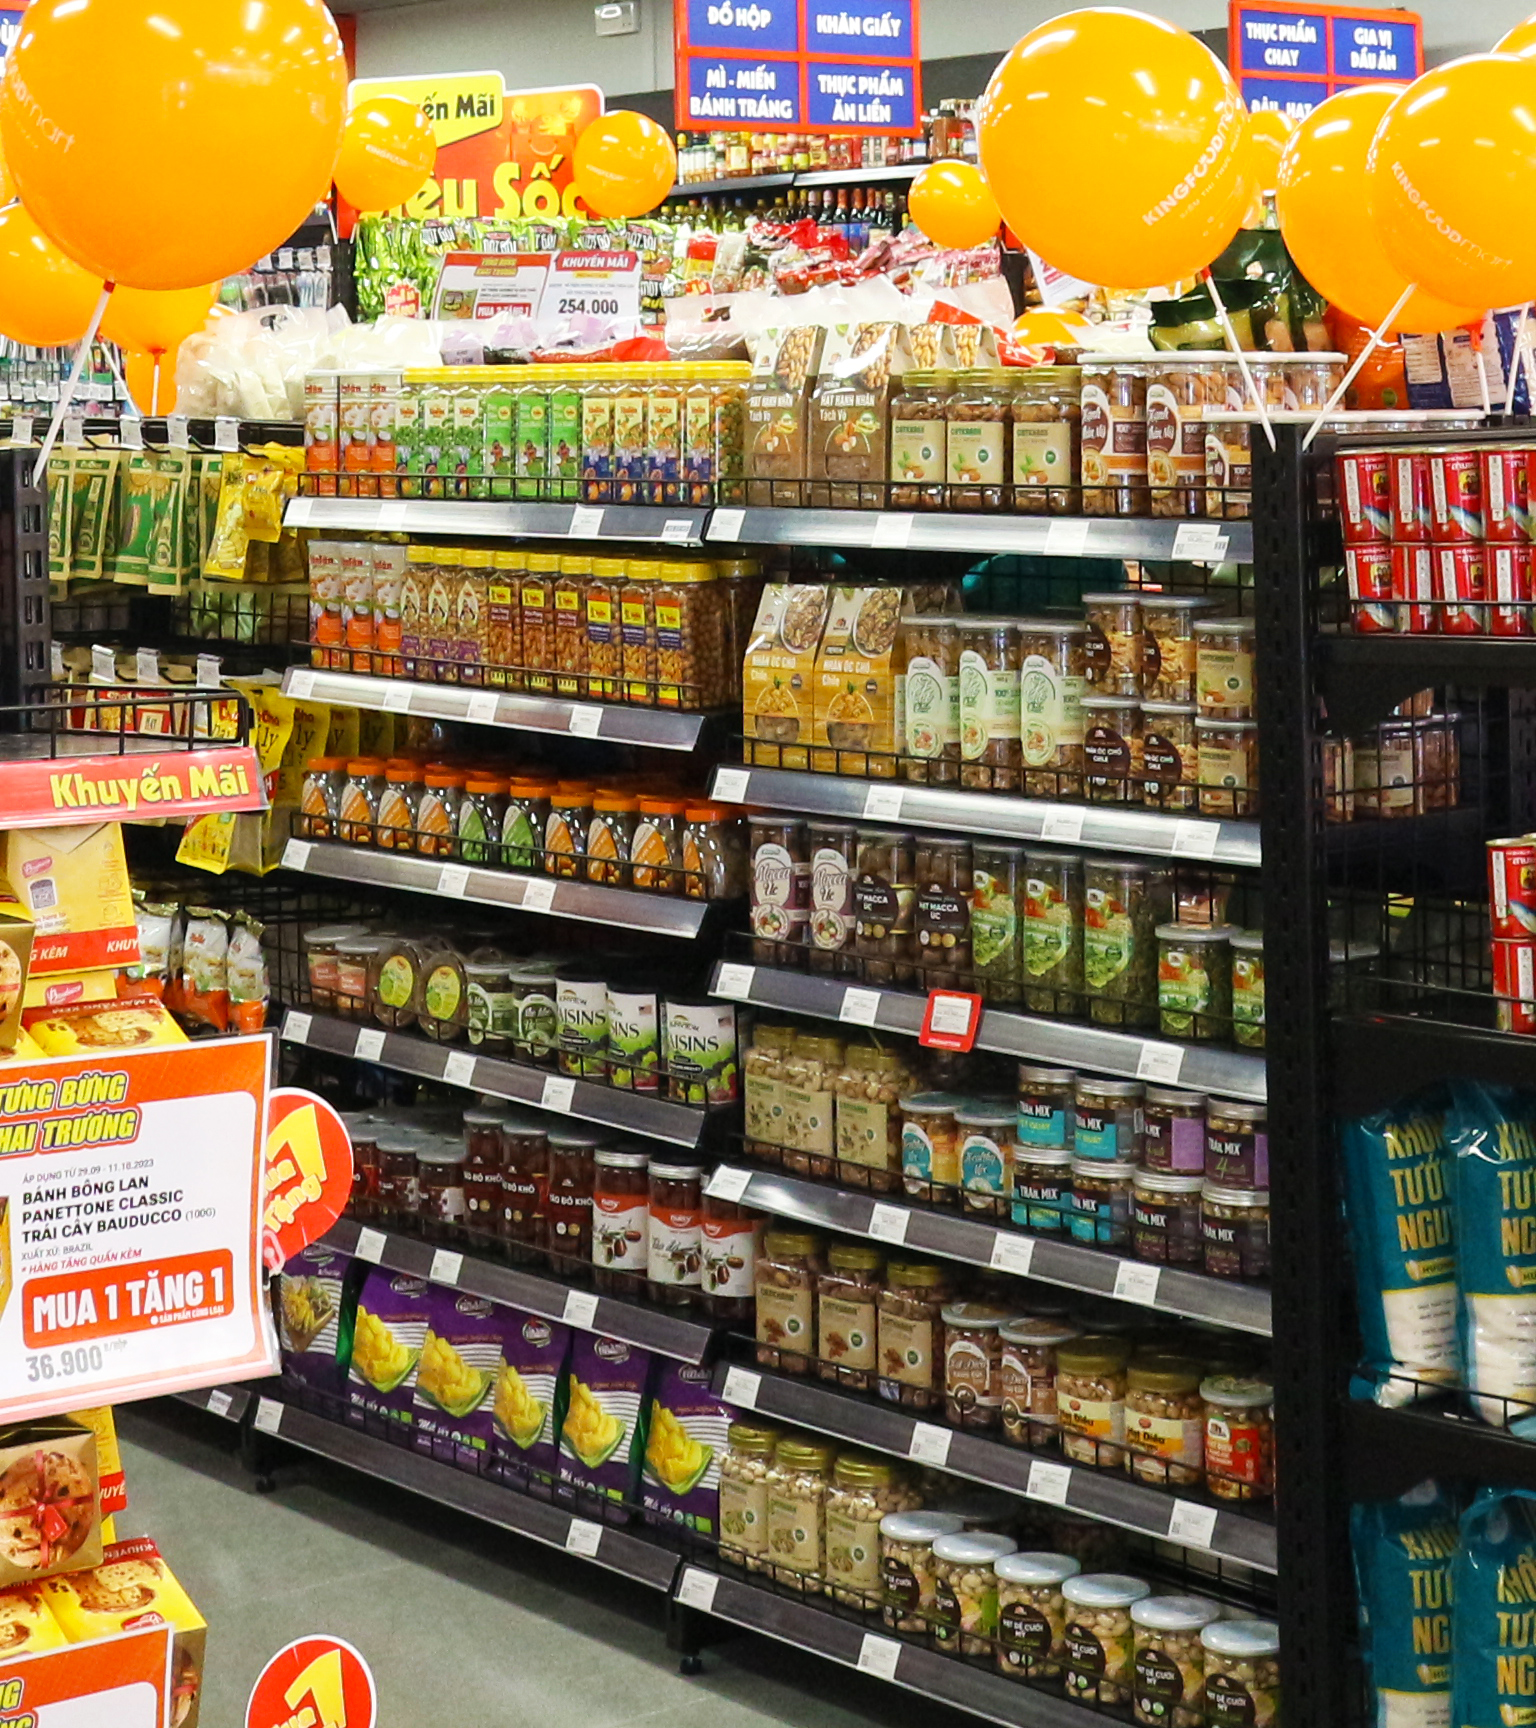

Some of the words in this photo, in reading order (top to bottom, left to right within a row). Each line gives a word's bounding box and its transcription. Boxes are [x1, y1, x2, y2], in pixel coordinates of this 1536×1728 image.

[708, 2, 735, 28] ĐỒ
[737, 3, 772, 31] HỘP
[816, 10, 857, 36] KHĂN
[861, 11, 902, 38] GIẤY
[1246, 22, 1278, 42] THỰC
[1279, 19, 1317, 44] PHẨM
[1354, 27, 1377, 46] GIA
[1378, 30, 1392, 50] VỊ
[1264, 48, 1300, 67] CHAY
[1351, 48, 1376, 70] DẦU
[1378, 48, 1396, 71] ĂN
[706, 69, 725, 90] MÌ
[739, 65, 775, 91] MIẾN
[818, 74, 855, 100] THỰC
[858, 70, 903, 98] PHẨM
[455, 93, 495, 118] Mãi
[690, 89, 737, 118] BÁNH
[740, 91, 792, 120] TRÁNG
[832, 96, 857, 123] ĂN
[859, 96, 892, 123] LIỀN
[1391, 161, 1513, 270] KINGFOODmart
[563, 252, 605, 268] KHUYẾN
[606, 254, 629, 268] MÃI
[559, 298, 618, 315] 254.000
[50, 762, 183, 812] Khuyến
[189, 764, 250, 800] Mãi
[40, 945, 68, 961] KÈM
[59, 1071, 129, 1108] BỪNG
[41, 1109, 140, 1150] TRƯƠNG
[22, 1187, 66, 1206] BÁNH
[71, 1179, 115, 1199] BÔNG
[119, 1175, 149, 1192] LAN
[22, 1199, 114, 1225] PANETTONE
[119, 1189, 184, 1210] CLASSIC
[22, 1224, 57, 1244] TRÁI
[61, 1220, 93, 1238] CÂY
[97, 1209, 182, 1232] BAUDUCCO
[29, 1259, 58, 1275] HÀNG
[61, 1255, 87, 1271] TẶNG
[89, 1250, 118, 1267] QUẤN
[120, 1248, 143, 1260] KÈM
[33, 1288, 98, 1334] MUA
[105, 1284, 118, 1320] 1
[125, 1269, 204, 1325] TẶNG
[211, 1267, 224, 1302] 1
[25, 1345, 103, 1382] 36.900
